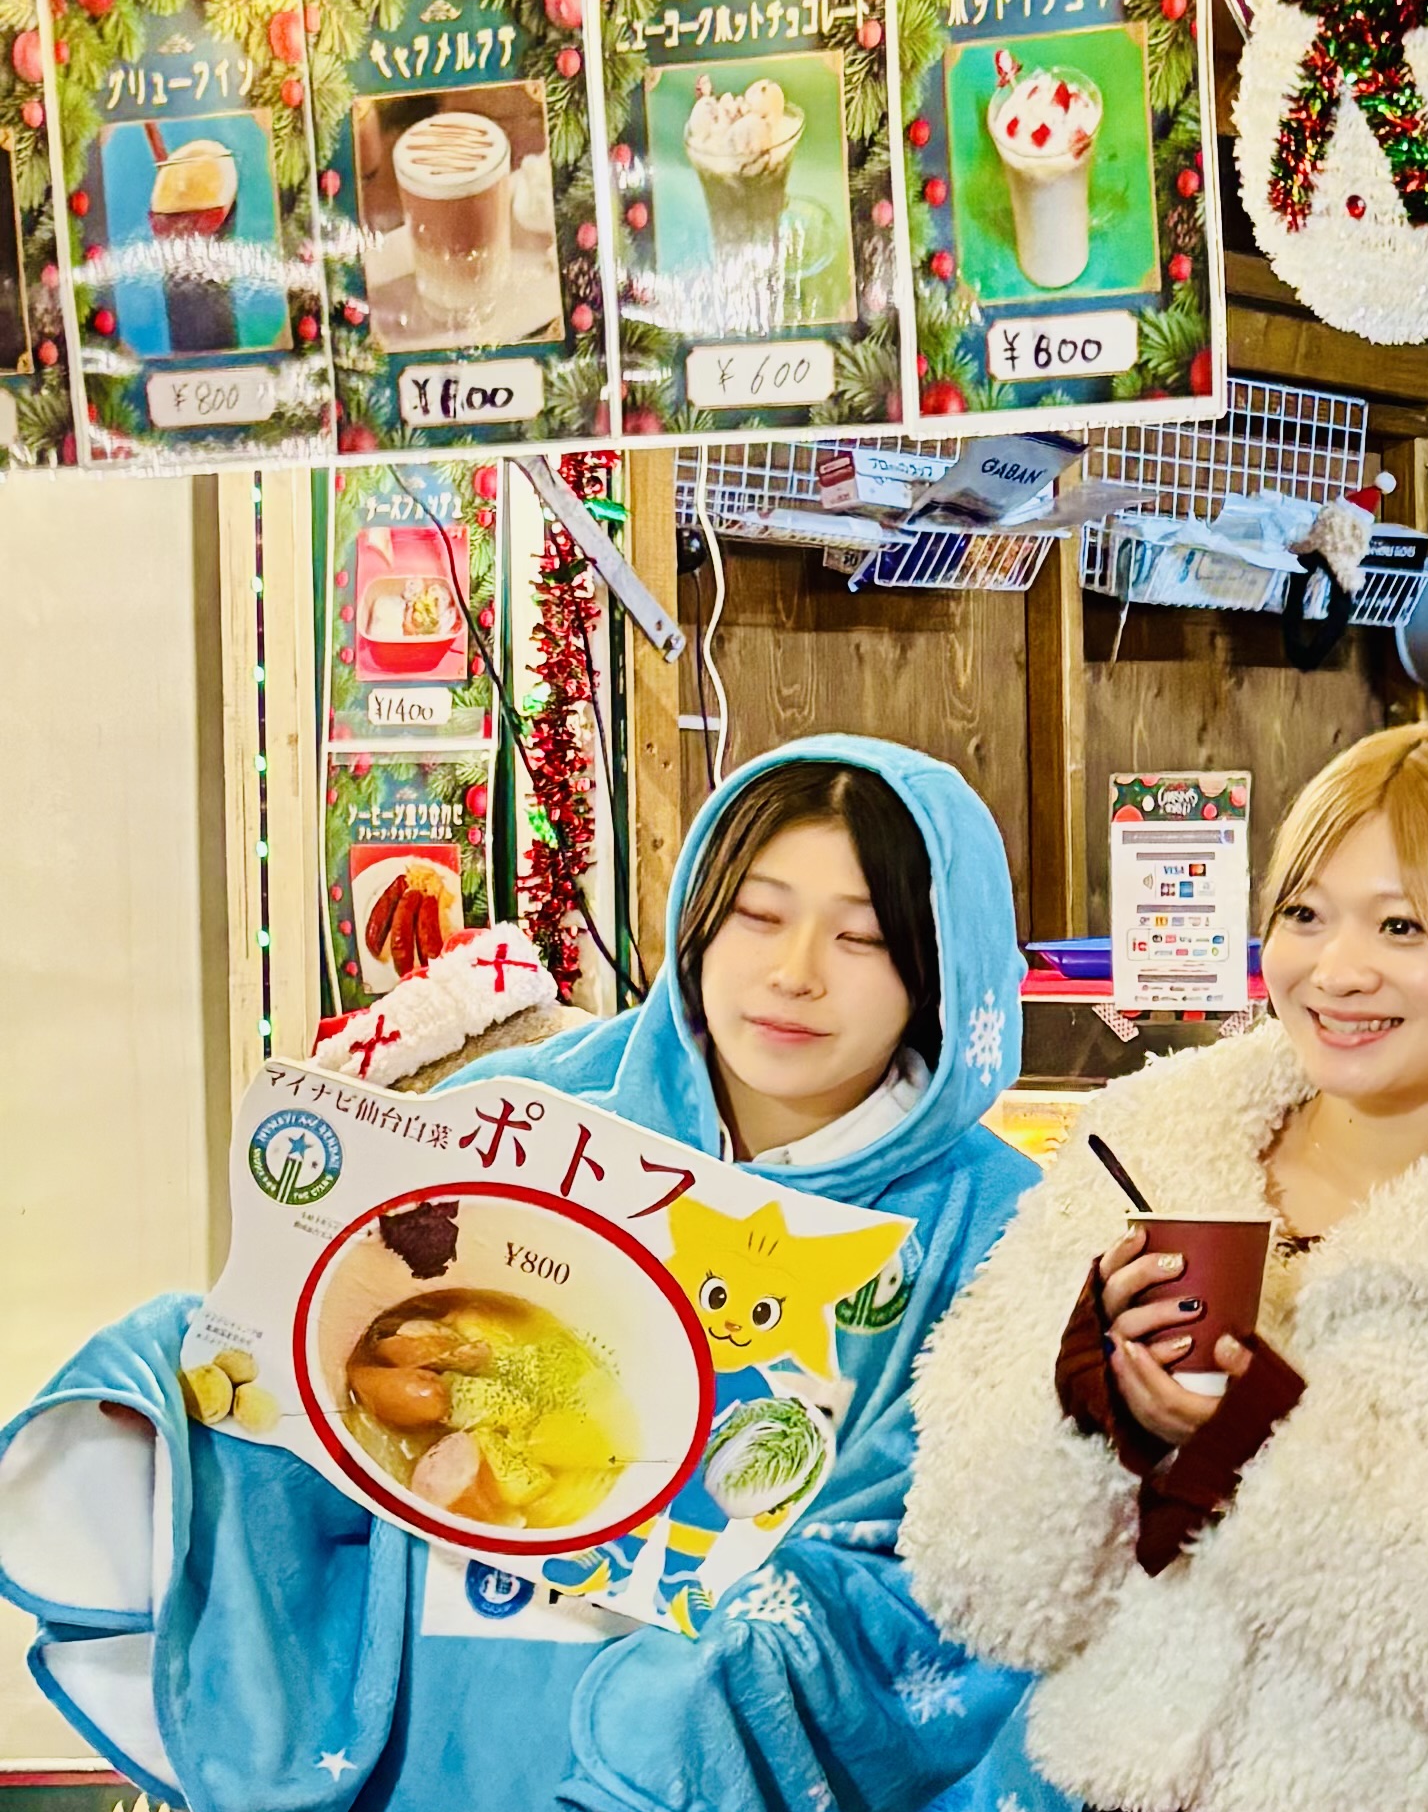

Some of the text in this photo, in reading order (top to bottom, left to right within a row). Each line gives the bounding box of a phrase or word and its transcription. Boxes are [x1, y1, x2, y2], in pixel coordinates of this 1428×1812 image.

[717, 355, 811, 395] ¥600
[981, 457, 1043, 485] GABAN
[373, 693, 435, 724] ¥1400
[264, 1066, 697, 1221] マイナビ仙台白菜 ポトフ
[503, 1241, 571, 1286] ¥800
